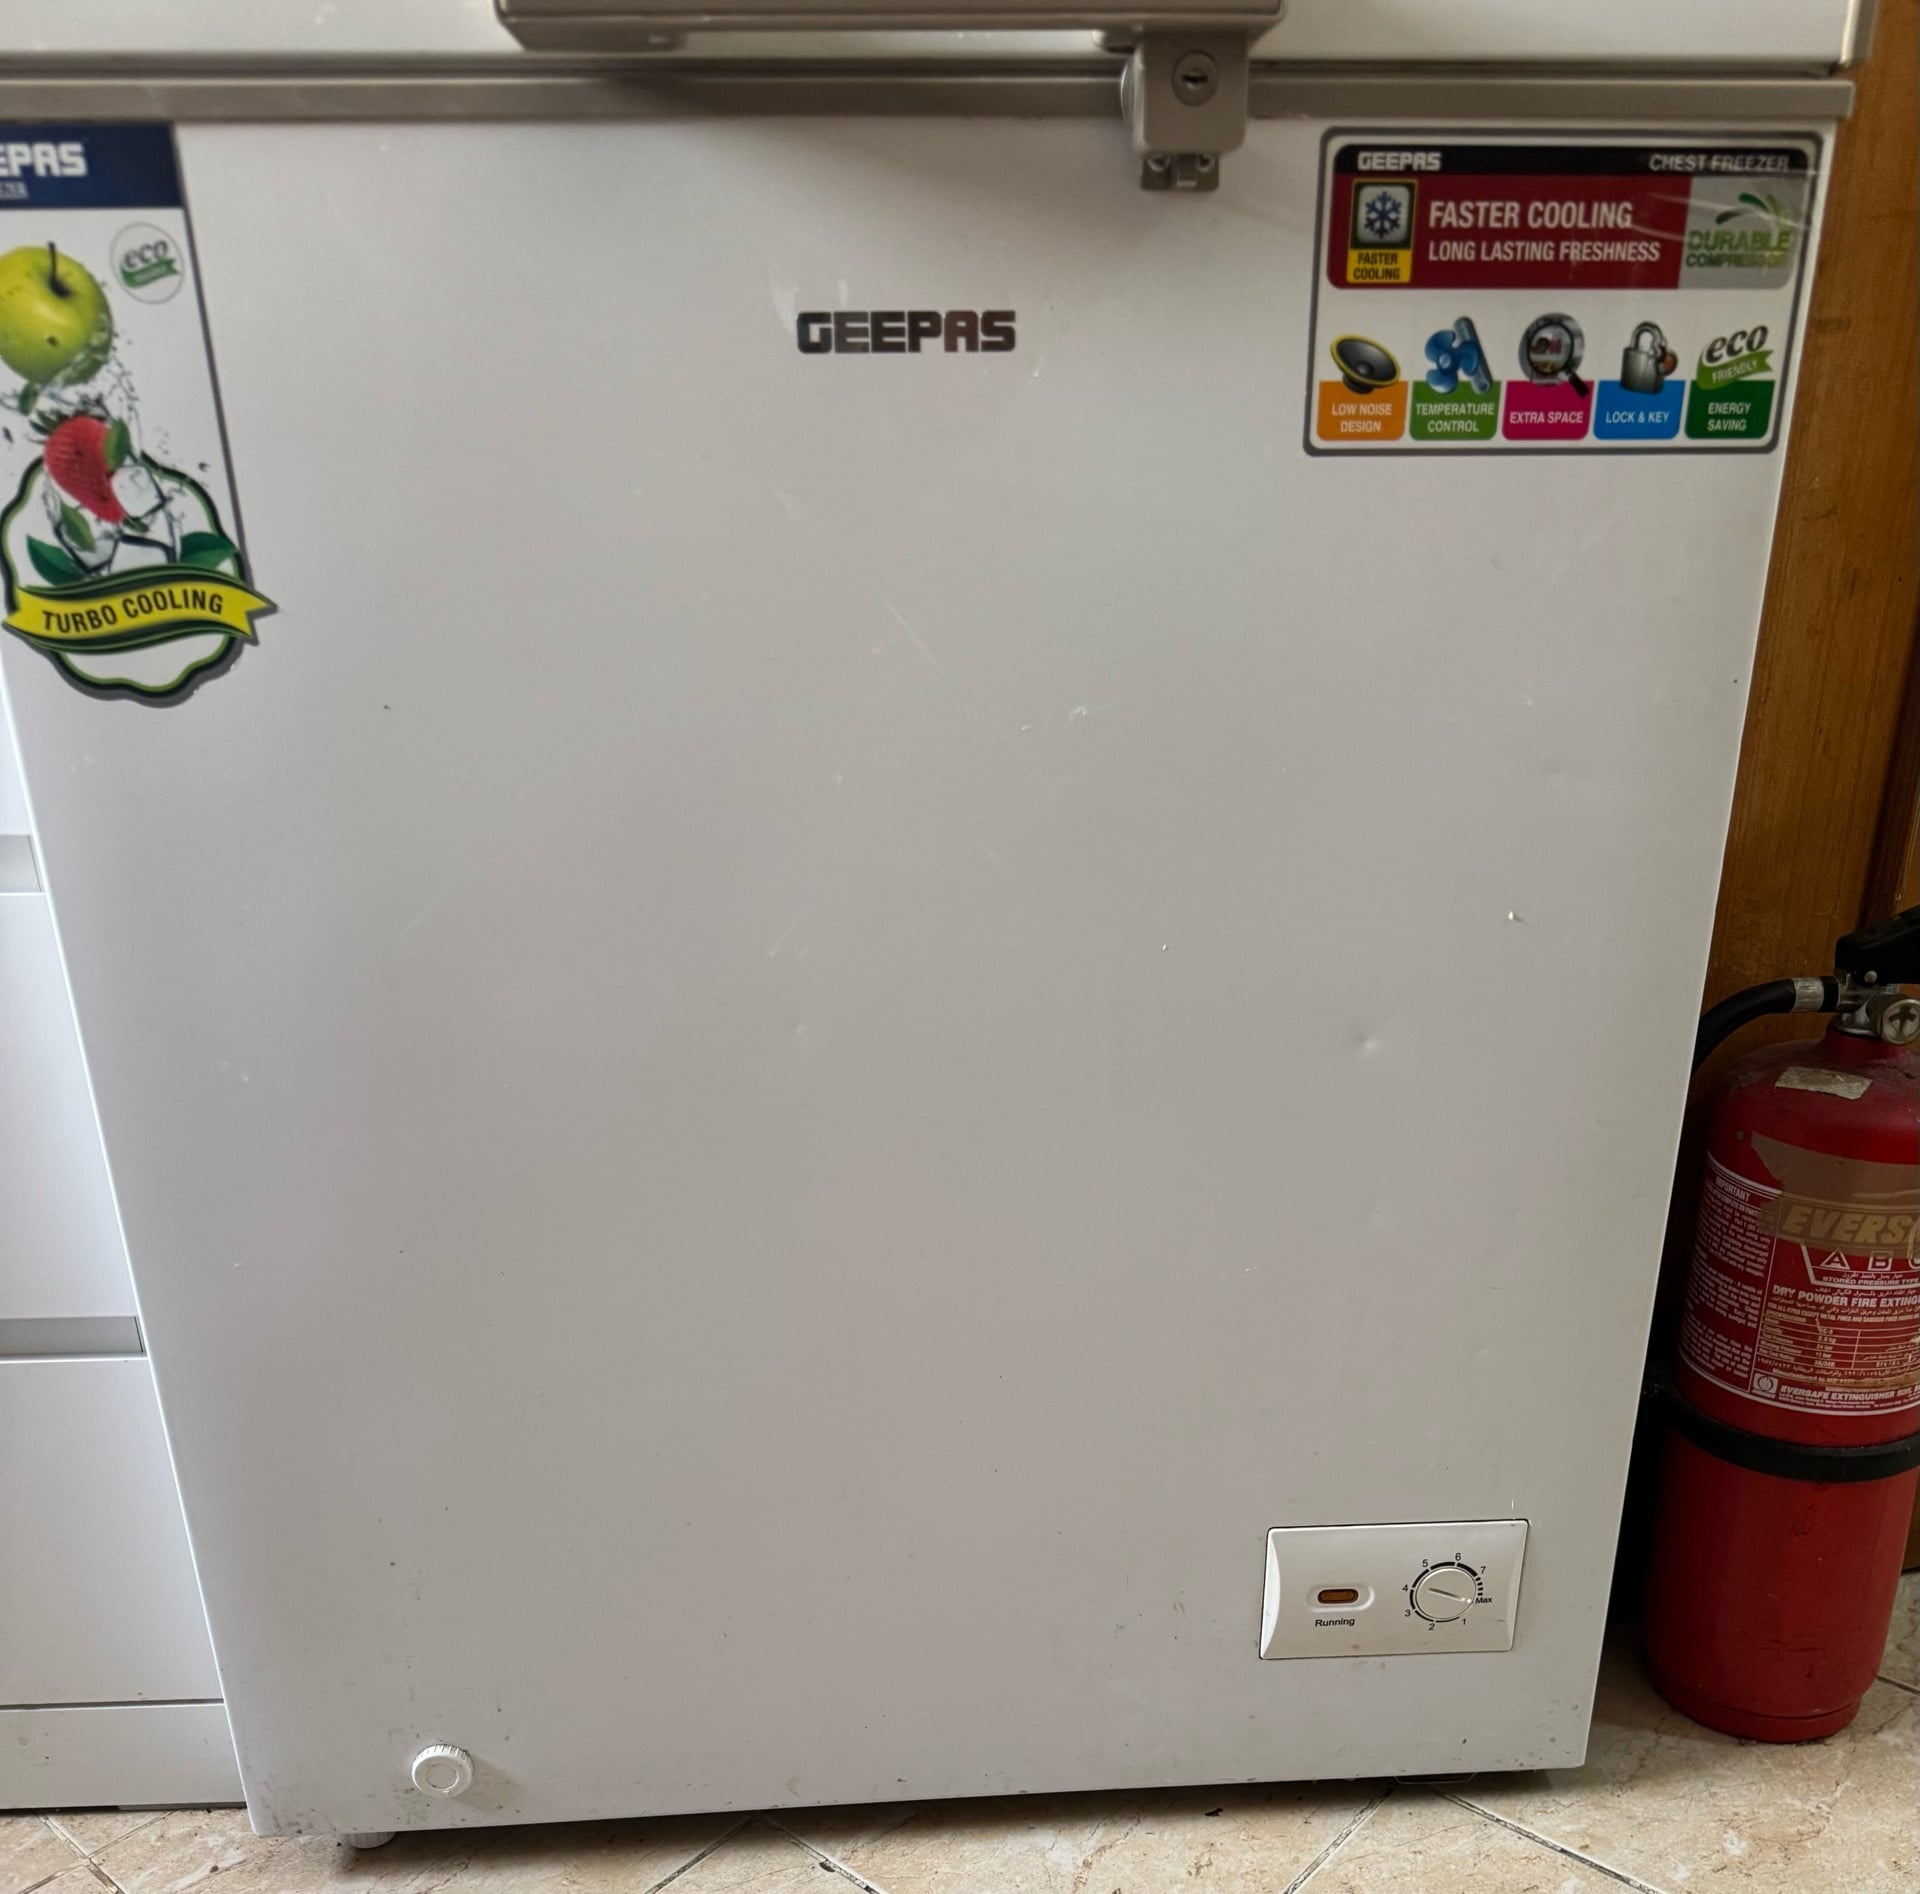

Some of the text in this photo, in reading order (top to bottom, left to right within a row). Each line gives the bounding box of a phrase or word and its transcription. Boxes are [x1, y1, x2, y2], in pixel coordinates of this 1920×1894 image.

[1357, 151, 1442, 171] GEEPAS
[1649, 154, 1790, 172] CHEST FREEZER
[1429, 201, 1634, 229] FASTER COOLING
[1686, 229, 1793, 251] DURABLE
[124, 240, 169, 269] eco
[1428, 240, 1661, 262] LONG LASTING FRESHNESS
[1357, 252, 1398, 265] FASTER
[1353, 267, 1401, 281] COOLING
[796, 310, 1016, 354] GEEPAS
[1705, 325, 1769, 364] eco
[1712, 360, 1758, 384] FRIENDLY
[1332, 403, 1393, 416] LOW NOISE
[1415, 403, 1495, 416] TEMPERATURE
[1707, 402, 1752, 415] ENERGY
[1509, 411, 1584, 424] EXTRA SPACE
[1605, 411, 1669, 424] LOCK & KEY
[1340, 420, 1382, 433] DESIGN
[1427, 420, 1479, 433] CONTROL
[1707, 419, 1747, 432] SAVING
[41, 588, 223, 634] TURBO COOLING
[1772, 1284, 1796, 1299] DRY
[1798, 1289, 1850, 1306] POWDER
[1850, 1297, 1877, 1308] FIRE
[1780, 1384, 1831, 1400] EVERSAFE
[1831, 1390, 1896, 1401] EXTINGUISHER
[1422, 1558, 1428, 1567] 5
[1455, 1552, 1462, 1561] 6
[1480, 1566, 1486, 1574] 7
[1402, 1584, 1409, 1592] 4
[1474, 1596, 1493, 1604] Max
[1404, 1609, 1411, 1617] 3
[1315, 1616, 1355, 1627] Running
[1428, 1623, 1435, 1631] 2
